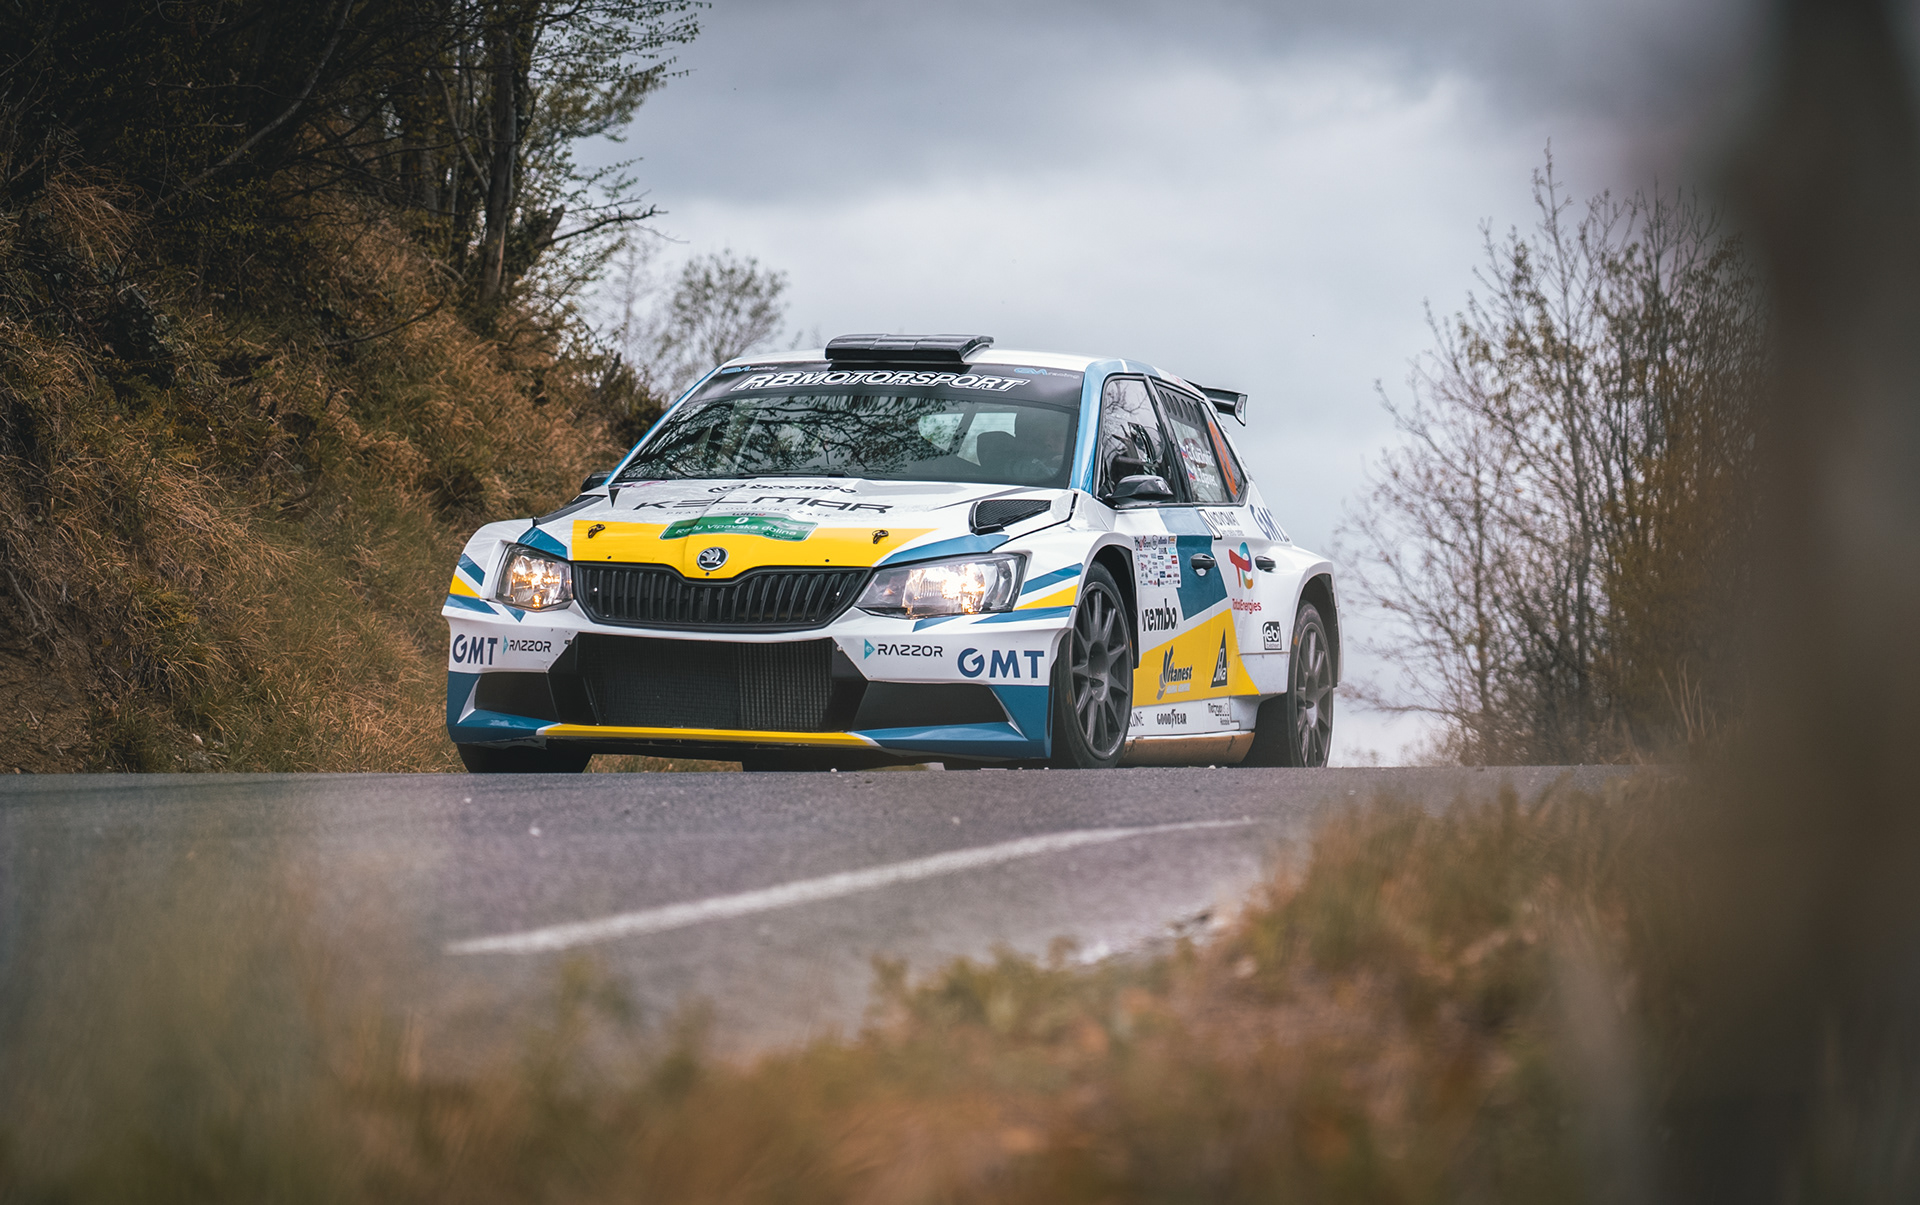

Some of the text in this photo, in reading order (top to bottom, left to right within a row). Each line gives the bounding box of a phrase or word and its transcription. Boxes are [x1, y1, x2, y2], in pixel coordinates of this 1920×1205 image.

[730, 370, 1031, 392] RBMOTORSPORT
[633, 496, 894, 514] KELMAR
[735, 516, 749, 525] 0
[762, 525, 797, 536] dolina
[1232, 598, 1262, 614] TotalEnergies
[1263, 623, 1280, 642] febi
[452, 633, 552, 665] GMT RAZZOR
[877, 643, 1045, 678] RAZZOR GMT
[1156, 711, 1187, 726] GOODYEAR
